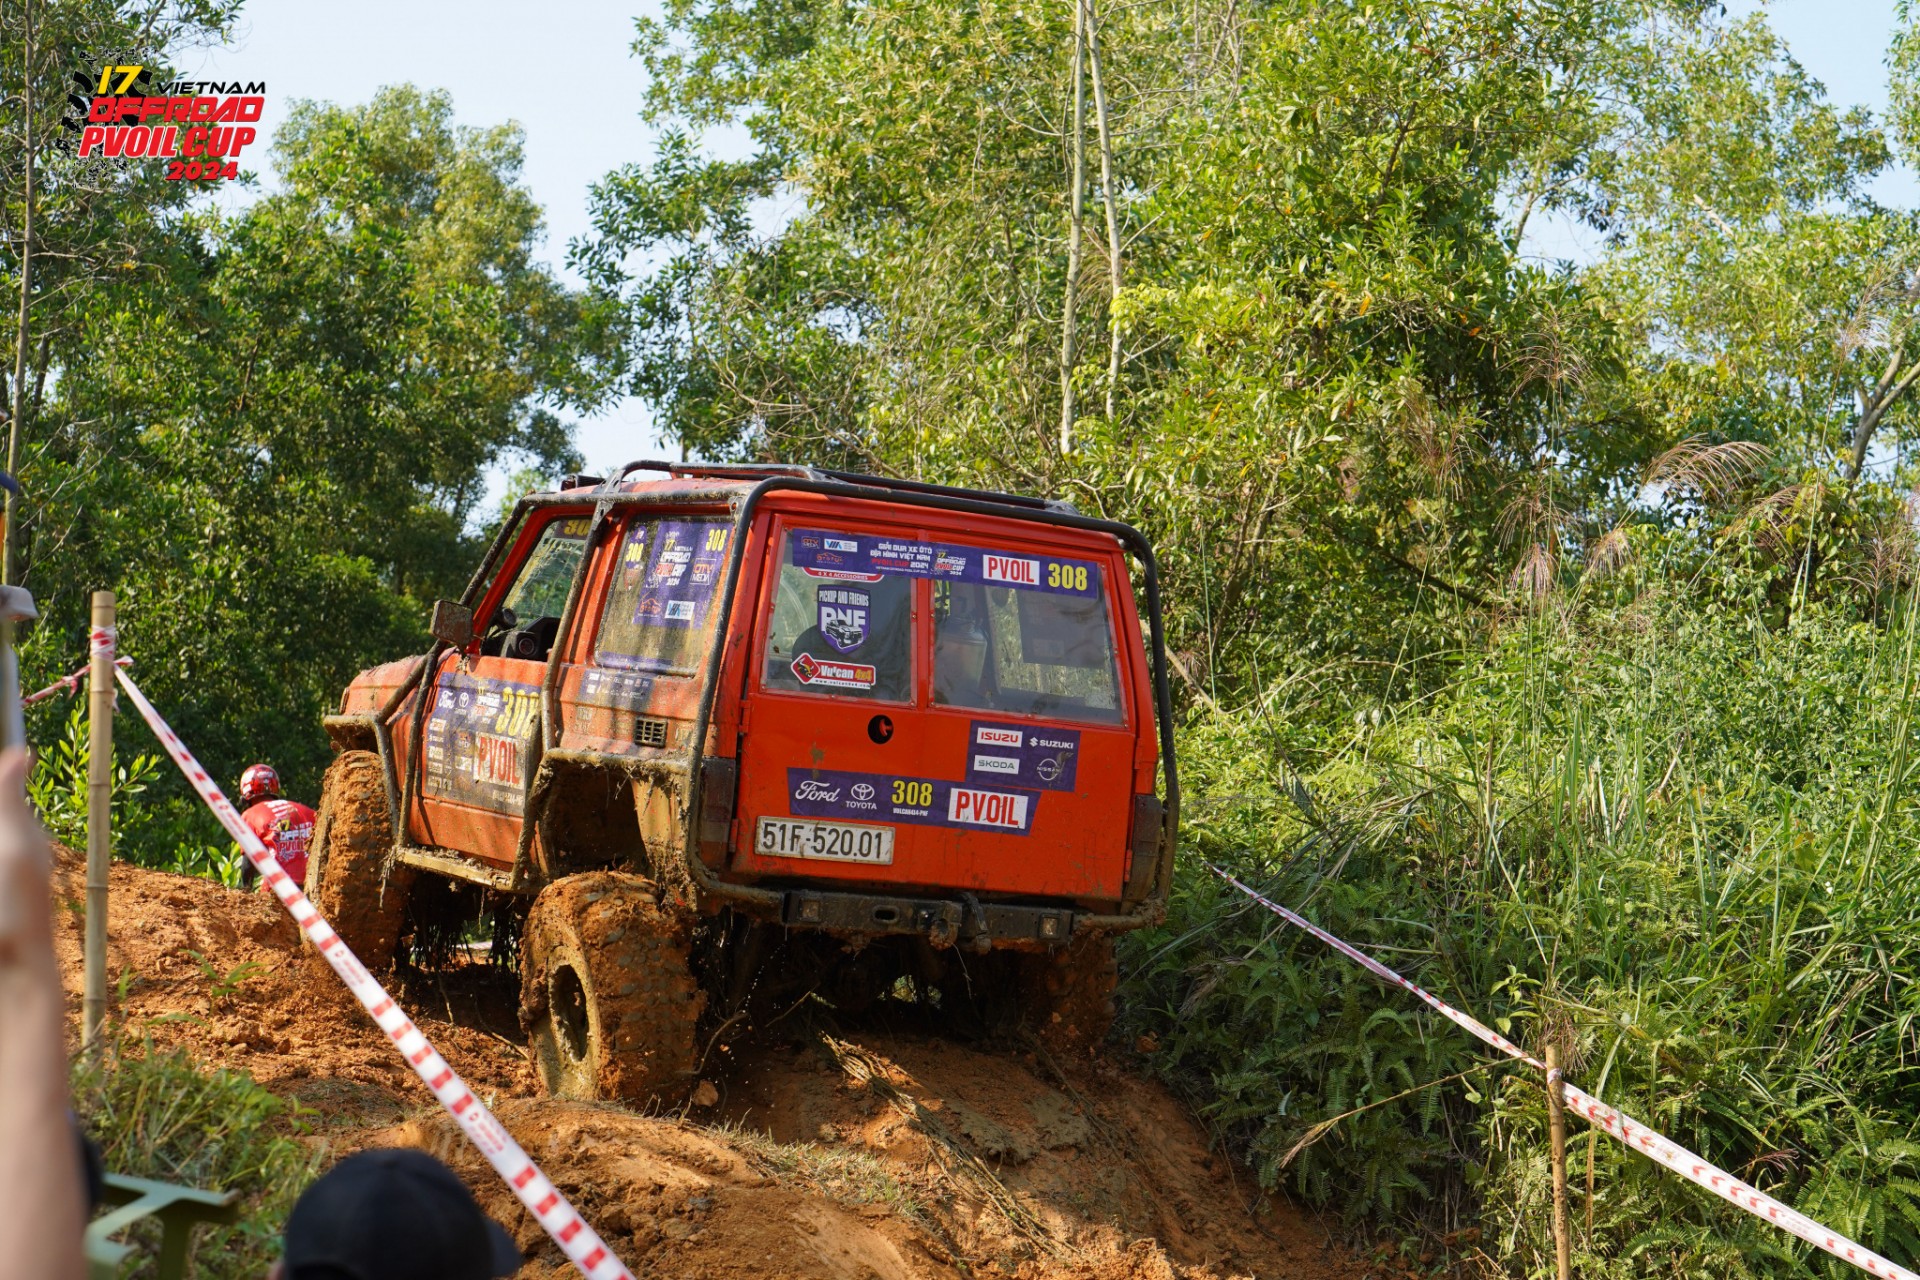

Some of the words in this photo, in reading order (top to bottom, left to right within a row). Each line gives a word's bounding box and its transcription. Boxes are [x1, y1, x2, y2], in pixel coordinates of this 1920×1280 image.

[564, 520, 592, 536] 30
[705, 528, 727, 552] 308
[910, 561, 929, 569] 2024
[833, 572, 868, 580] ACCESSORIES
[988, 557, 1035, 583] PVOIL
[1047, 563, 1088, 591] 308
[818, 590, 837, 603] PICKUP
[837, 591, 848, 604] AND
[848, 592, 869, 607] FRIENDS
[821, 665, 854, 679] Vulcan
[438, 690, 457, 709] Ford
[980, 731, 1019, 743] ISUZU
[1039, 739, 1074, 749] SUZUKI
[477, 735, 520, 785] PVOIL
[795, 780, 841, 803] Ford
[891, 780, 933, 807] 308
[845, 800, 877, 810] TOYOTA
[954, 790, 1019, 826] PVOIL
